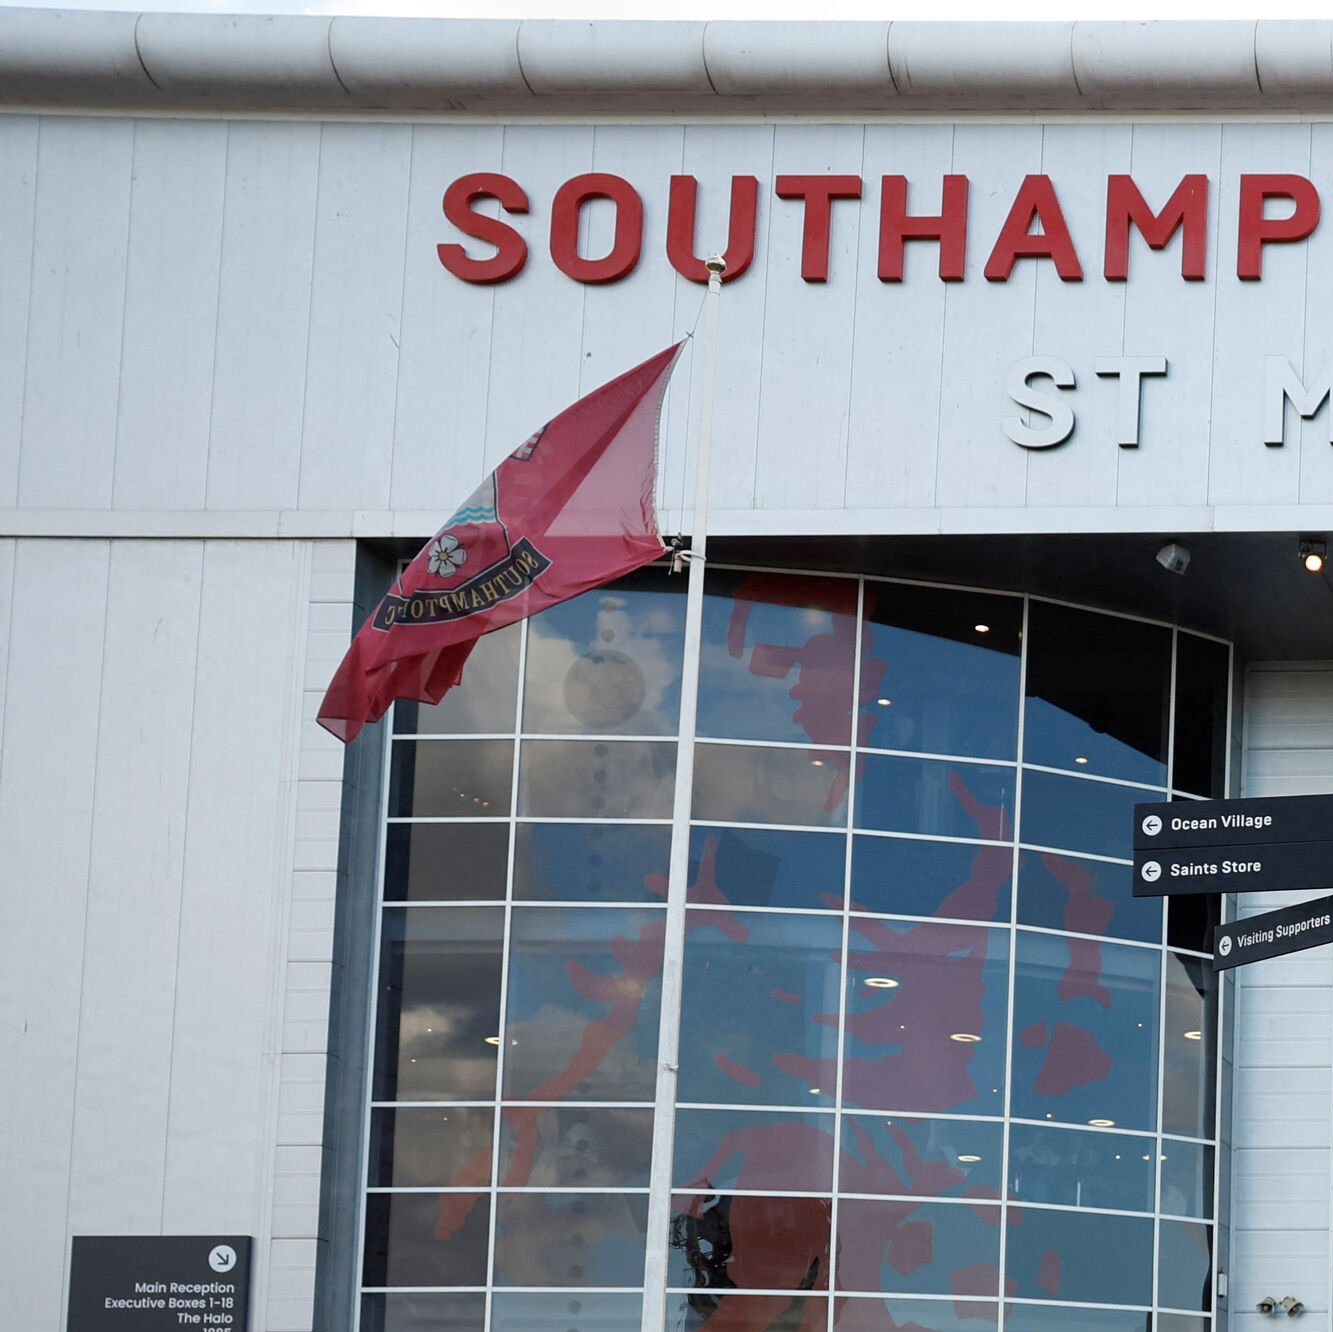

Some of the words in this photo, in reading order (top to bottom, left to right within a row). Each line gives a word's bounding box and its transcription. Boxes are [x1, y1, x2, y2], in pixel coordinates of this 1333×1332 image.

[1003, 354, 1169, 450] ST
[1171, 816, 1217, 831] Ocean
[1221, 813, 1273, 830] Village
[1170, 862, 1218, 876] Saints
[1222, 859, 1262, 874] Store
[1237, 928, 1273, 948] Visiting
[1276, 912, 1330, 942] Supporters
[135, 1282, 167, 1293] Main
[170, 1282, 234, 1296] Reception
[105, 1298, 165, 1308] Executive
[169, 1298, 206, 1308] Boxes
[209, 1298, 233, 1308] 1-18
[177, 1313, 200, 1323] The
[204, 1313, 233, 1323] Halo
